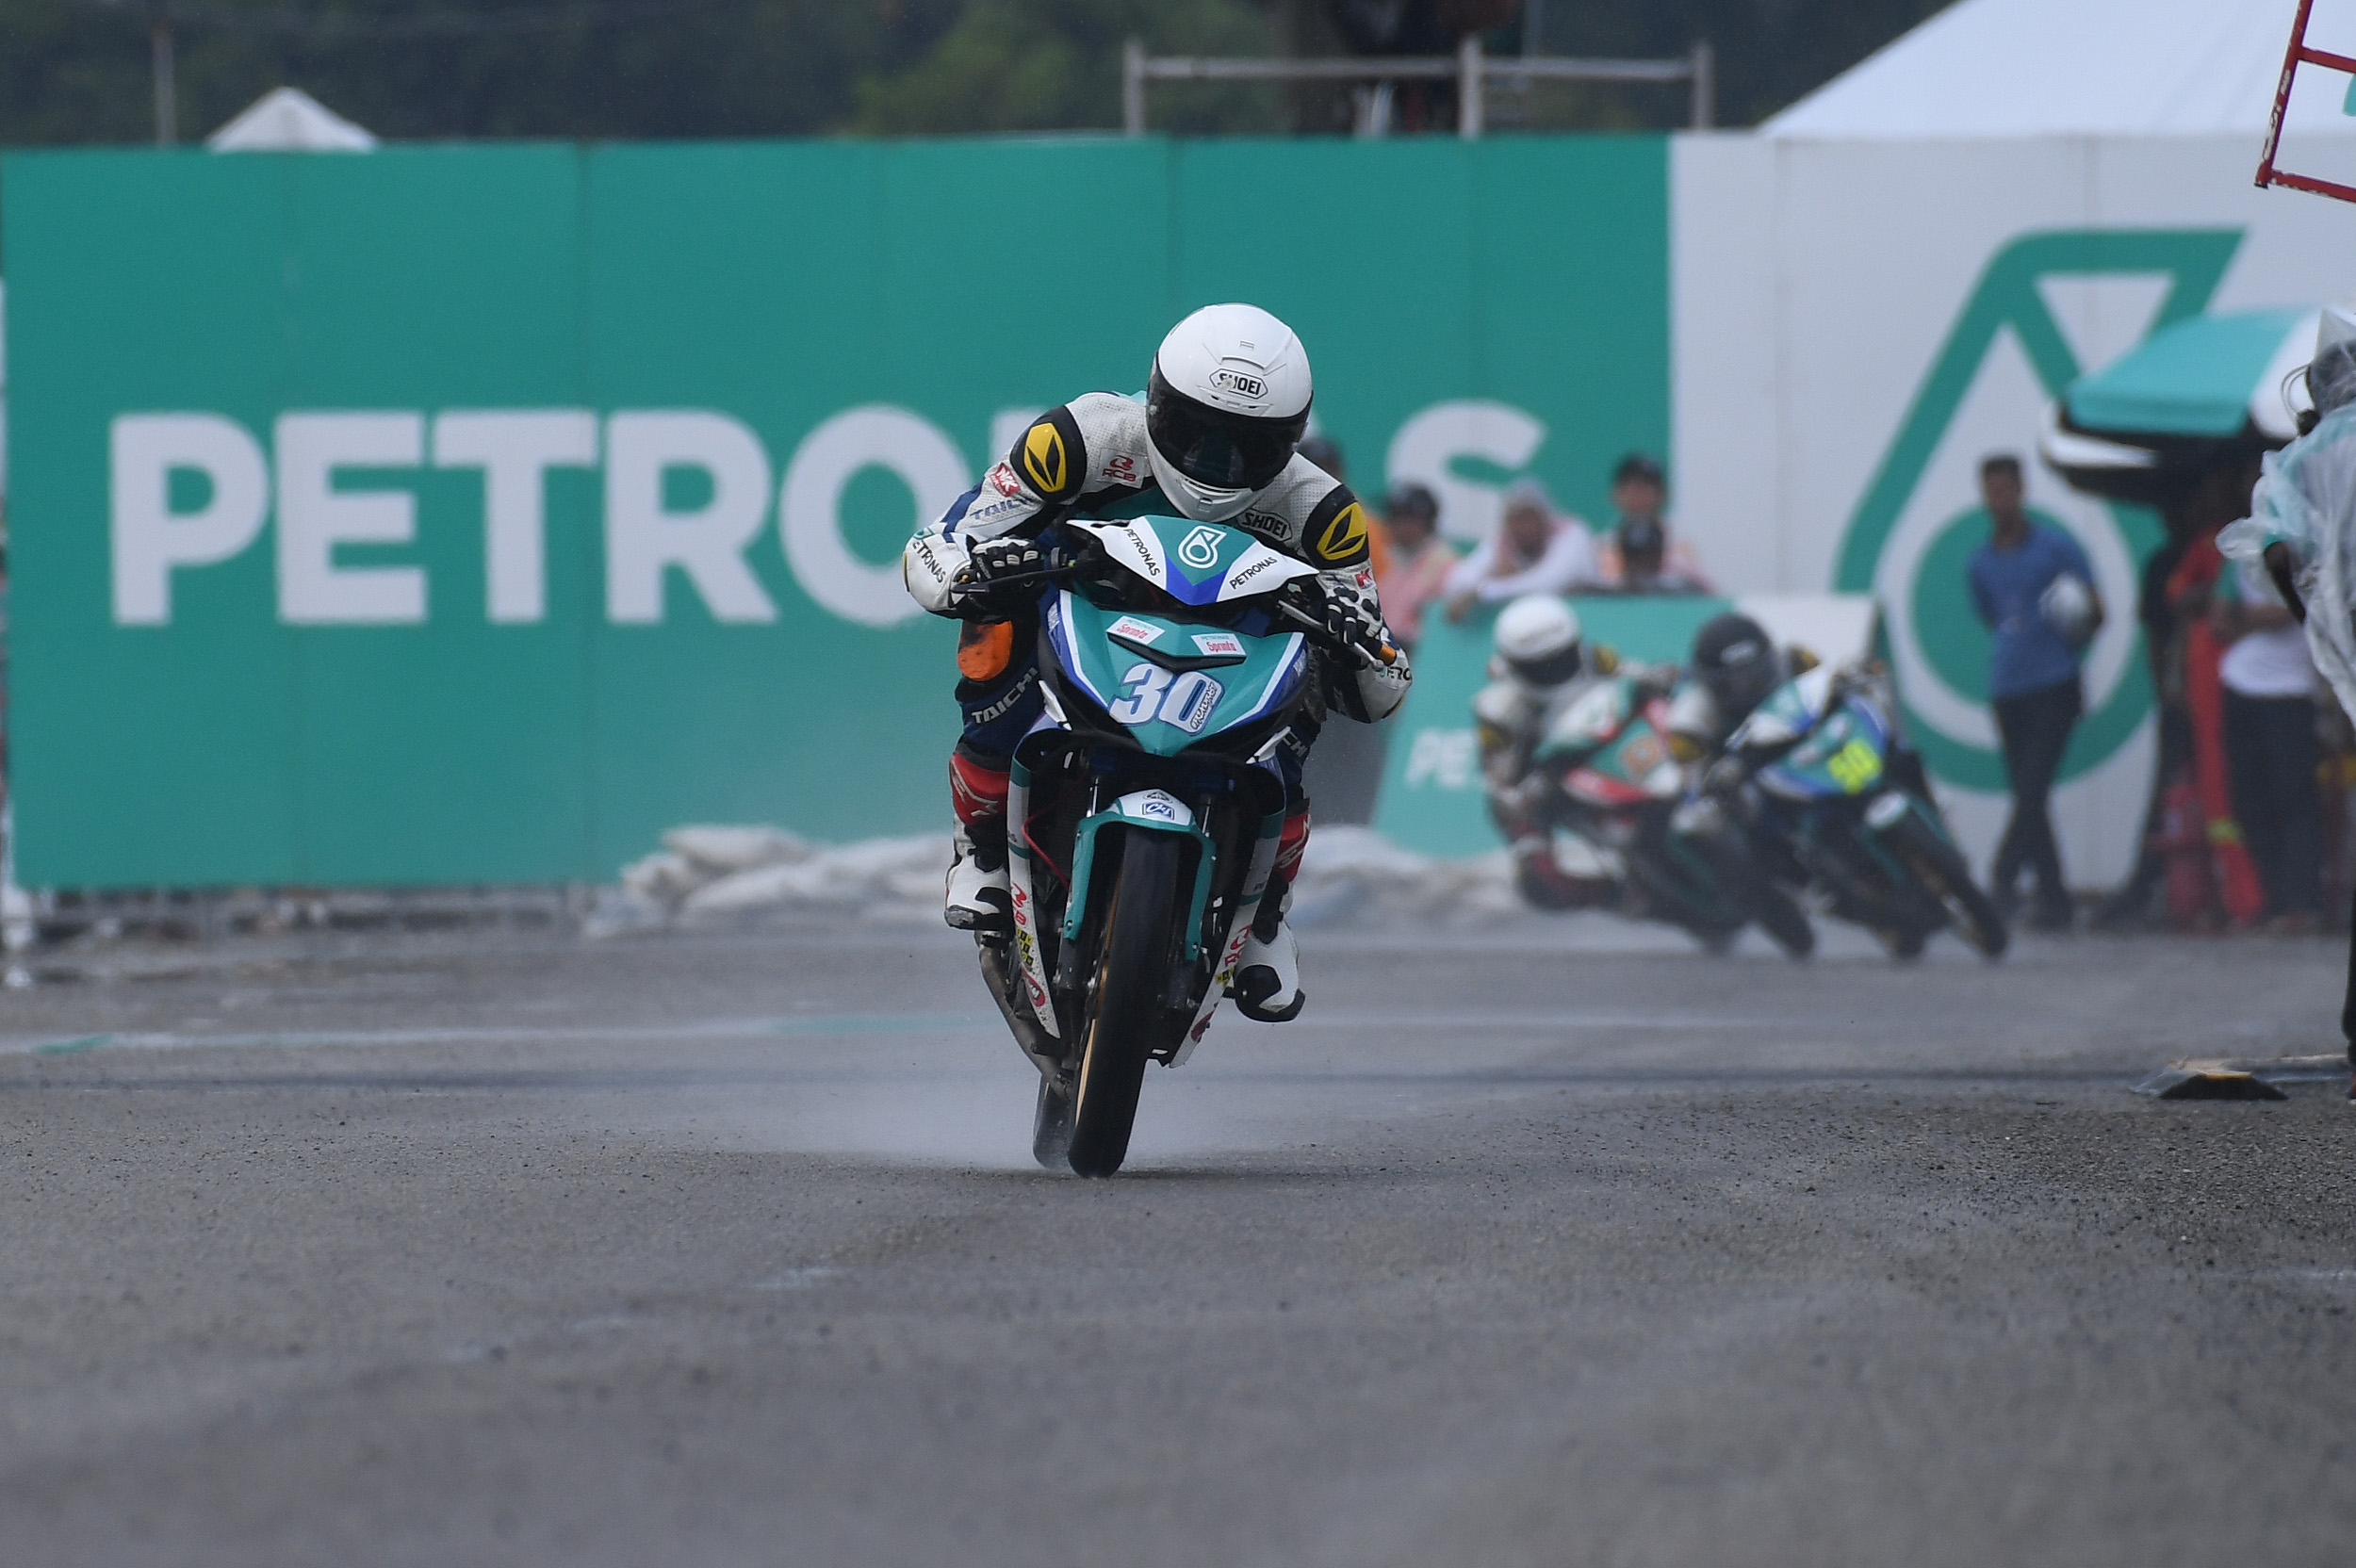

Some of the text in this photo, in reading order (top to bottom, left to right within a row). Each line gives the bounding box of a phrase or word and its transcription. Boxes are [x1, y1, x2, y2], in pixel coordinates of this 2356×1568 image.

[1103, 468, 1137, 482] RCB
[110, 400, 1546, 628] PETROS
[1242, 511, 1287, 538] SHOEI
[912, 539, 947, 583] ETRONAS
[1124, 528, 1161, 577] PETRONAS
[1229, 556, 1278, 590] PETRONAS
[1108, 662, 1225, 736] 30
